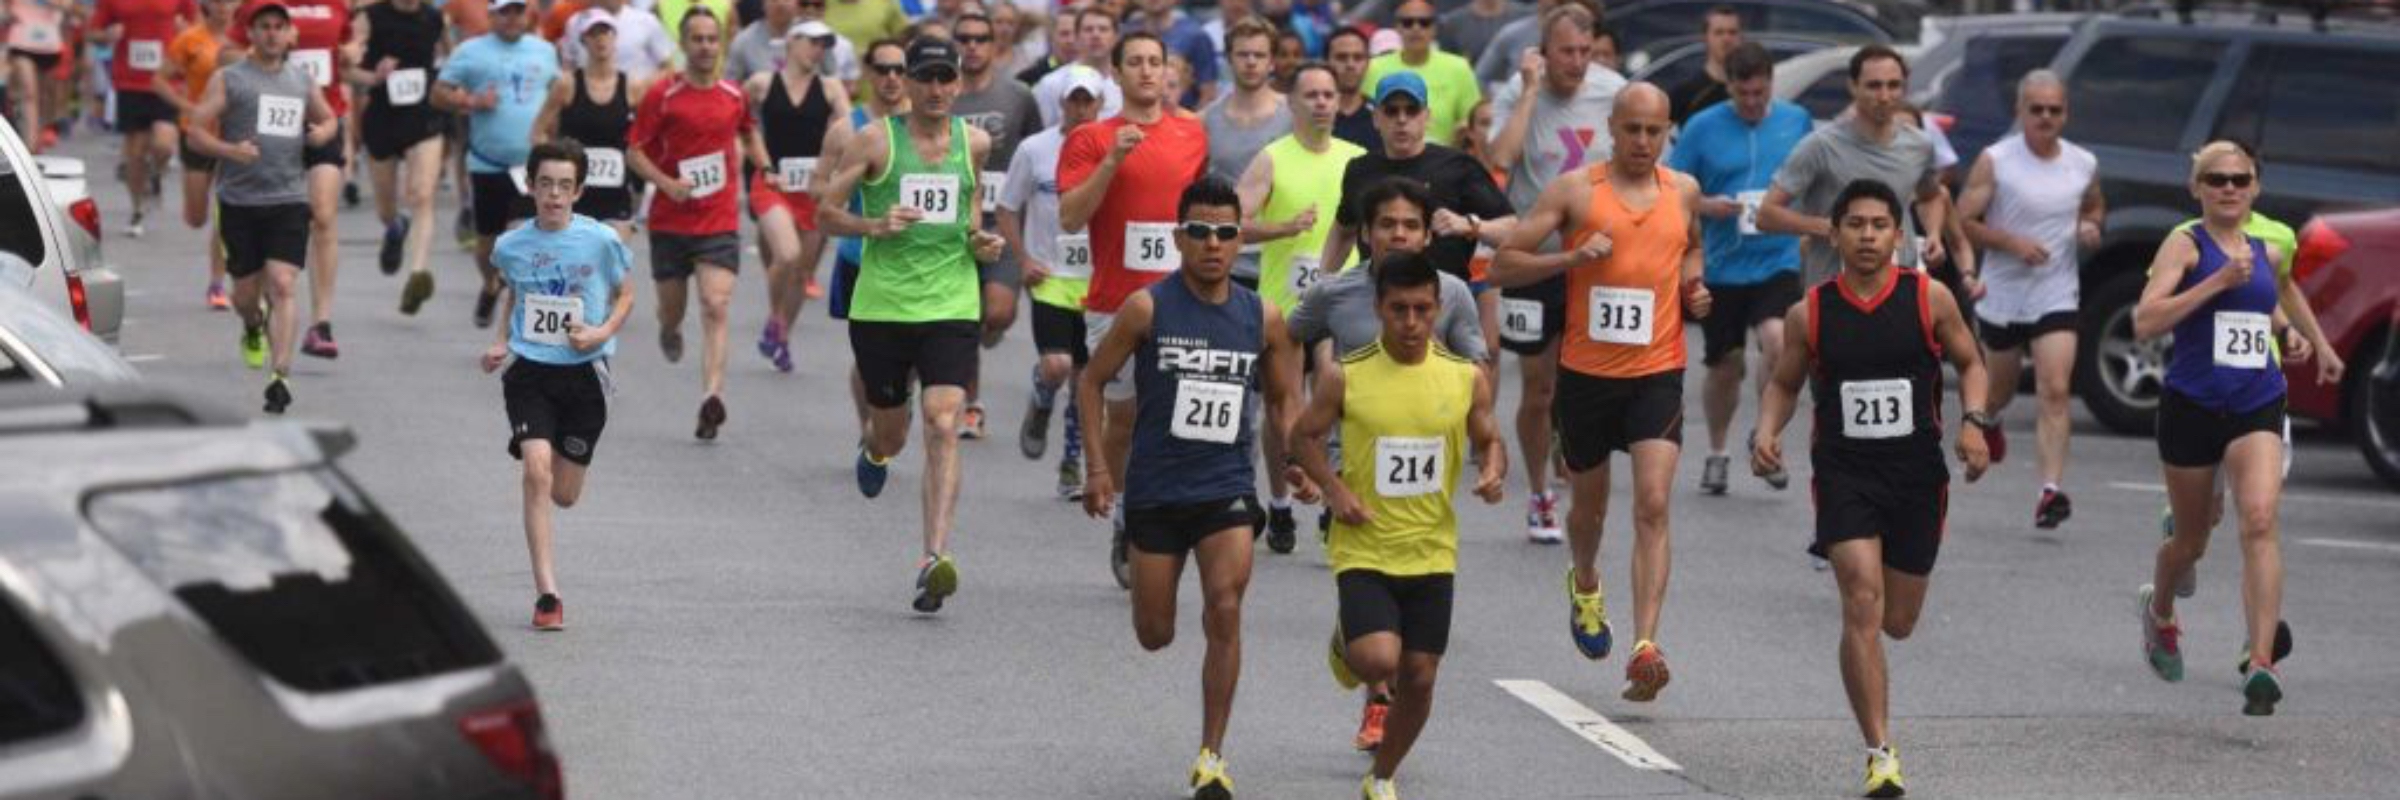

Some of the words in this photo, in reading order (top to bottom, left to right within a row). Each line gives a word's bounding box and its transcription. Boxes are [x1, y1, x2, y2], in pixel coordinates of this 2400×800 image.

[268, 106, 297, 127] 327
[690, 164, 719, 188] 312
[913, 188, 948, 212] 183
[1141, 237, 1165, 260] 56
[534, 308, 572, 334] 204
[1600, 302, 1642, 331] 313
[2227, 328, 2266, 355] 236
[1185, 397, 1231, 428] 216
[1854, 396, 1900, 425] 213
[1389, 454, 1436, 485] 214
